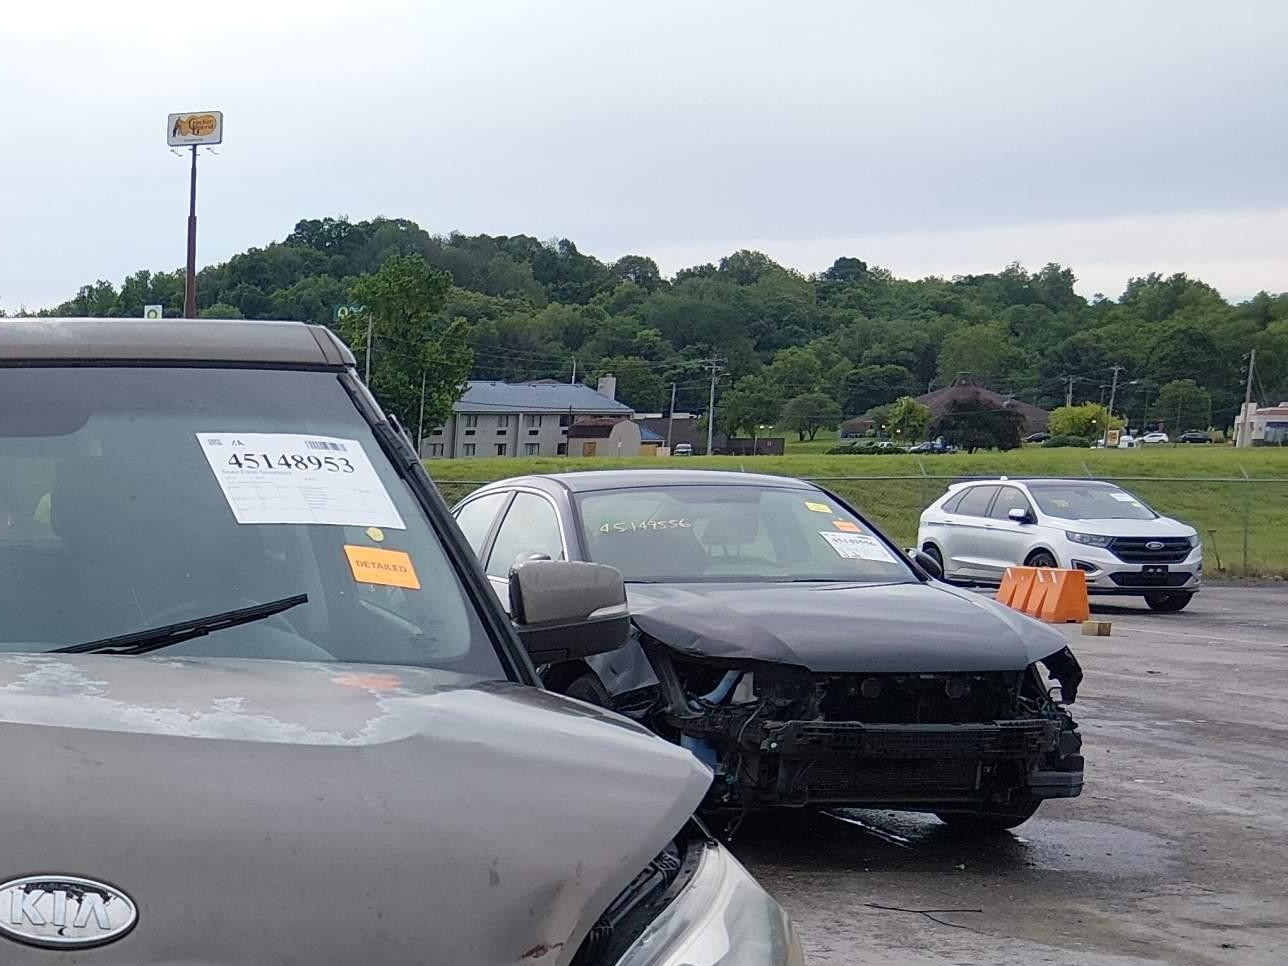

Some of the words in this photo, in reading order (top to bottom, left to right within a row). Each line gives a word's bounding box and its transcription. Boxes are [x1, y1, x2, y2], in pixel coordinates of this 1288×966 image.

[228, 453, 355, 474] 45148953
[356, 560, 407, 573] DETAILED
[10, 889, 112, 930] KIA
